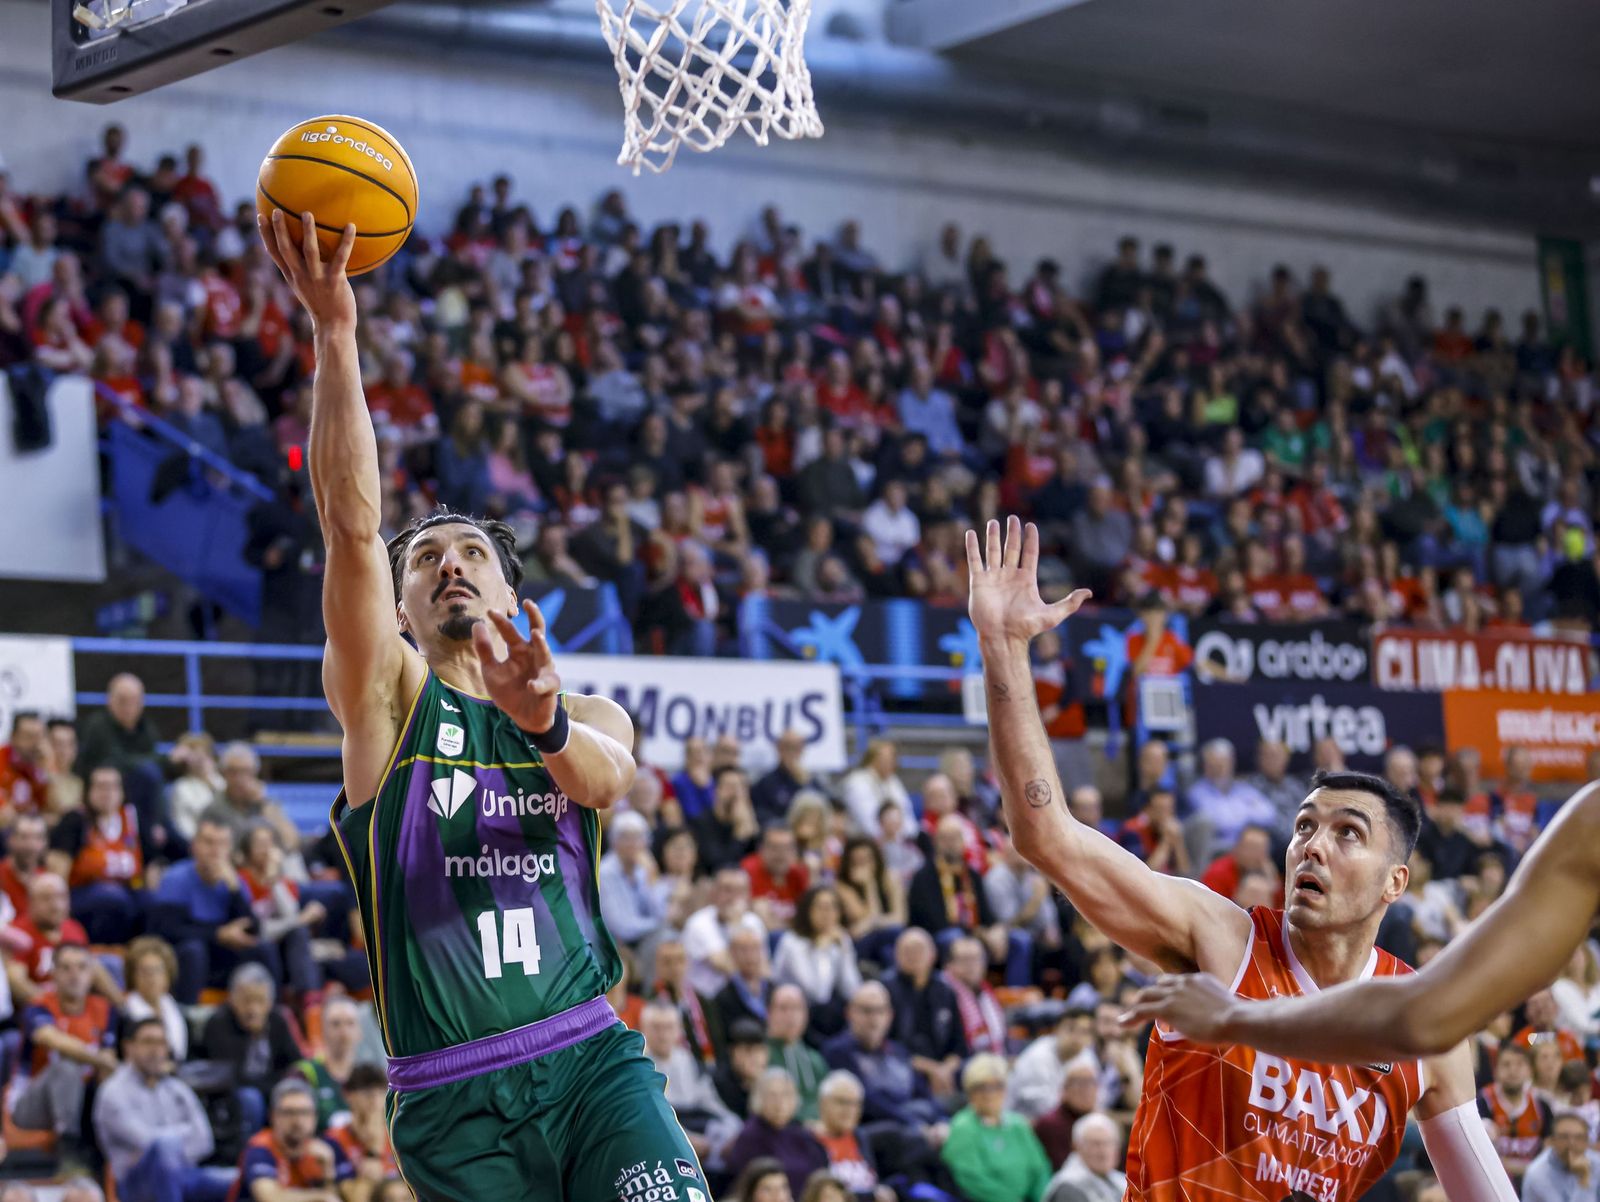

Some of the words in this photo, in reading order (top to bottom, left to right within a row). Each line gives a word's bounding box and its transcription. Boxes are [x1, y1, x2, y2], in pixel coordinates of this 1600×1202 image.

[333, 135, 393, 171] endesa
[1253, 694, 1386, 756] virtea
[482, 787, 568, 822] Unicaja
[445, 844, 555, 883] málaga
[477, 907, 541, 979] 14
[1248, 1050, 1388, 1146] BAXI
[614, 1160, 647, 1189] sabor
